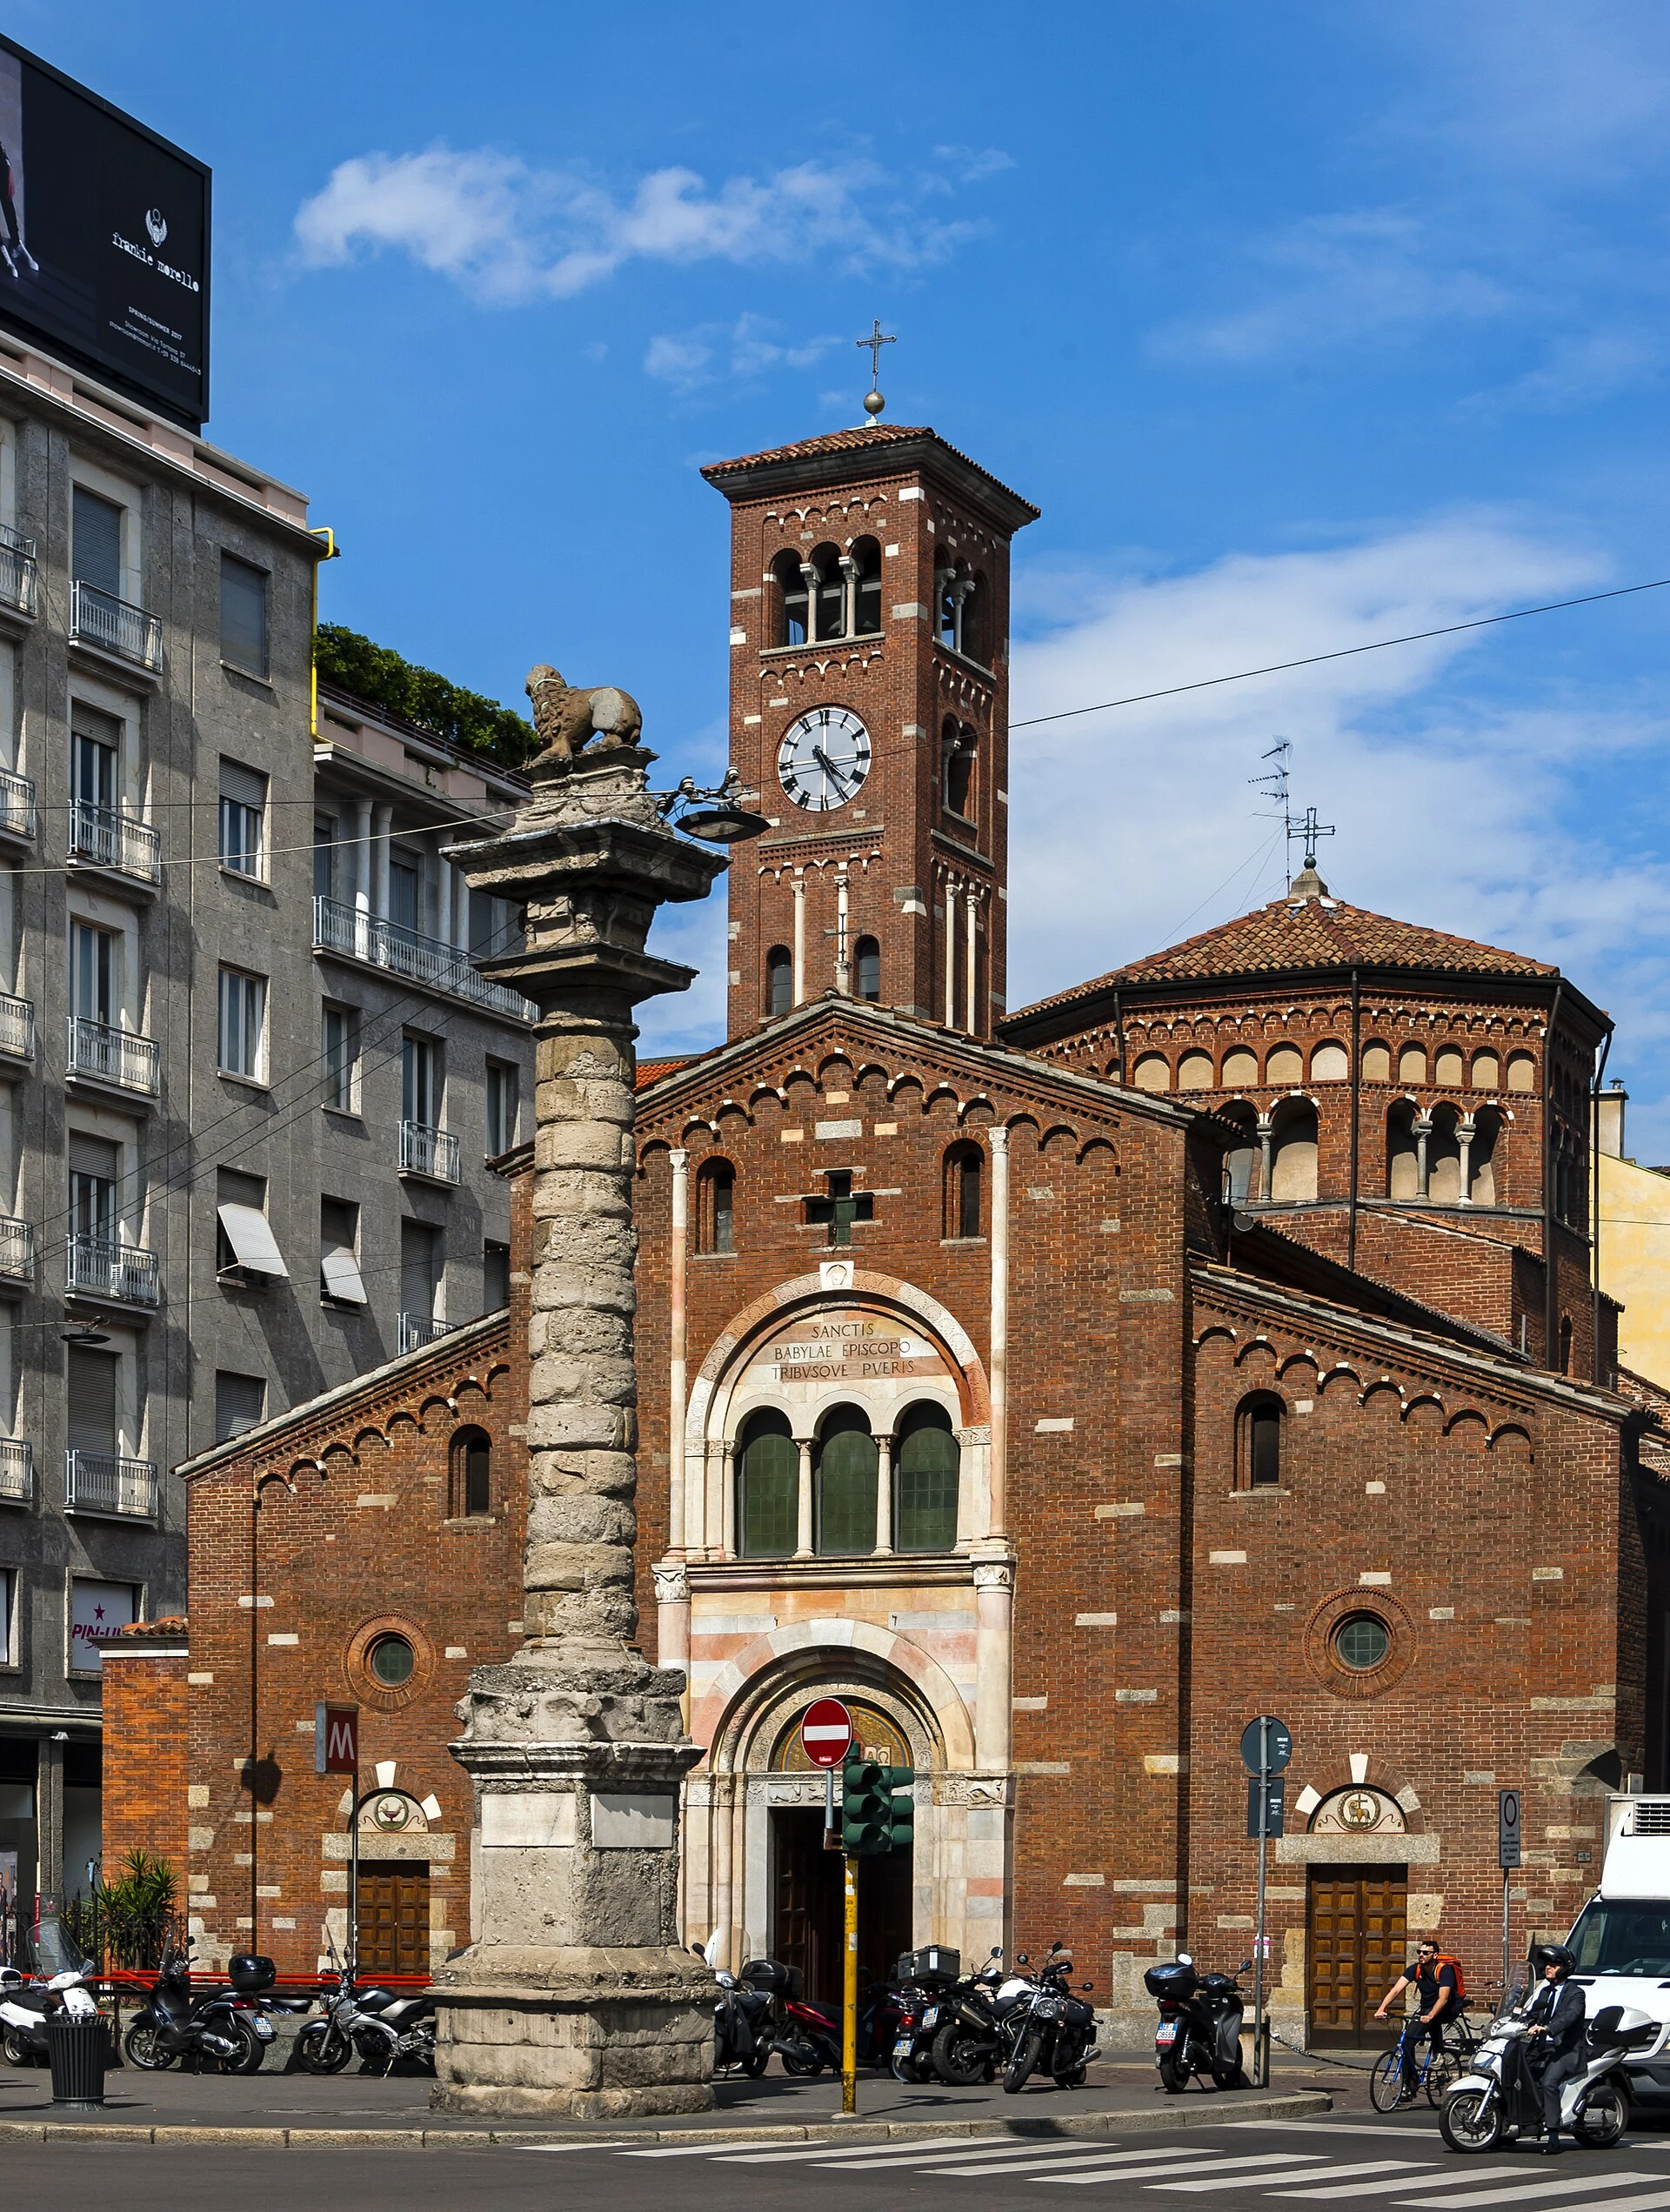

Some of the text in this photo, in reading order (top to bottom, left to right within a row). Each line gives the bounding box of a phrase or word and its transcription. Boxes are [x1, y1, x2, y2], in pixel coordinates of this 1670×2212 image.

[112, 231, 199, 292] frankie morello
[812, 1323, 874, 1339] SANCTIS
[774, 1340, 911, 1360] BABYLAE EPISCOPO
[772, 1360, 914, 1380] TRIBVSQVE PVERIS
[328, 1721, 355, 1761] M
